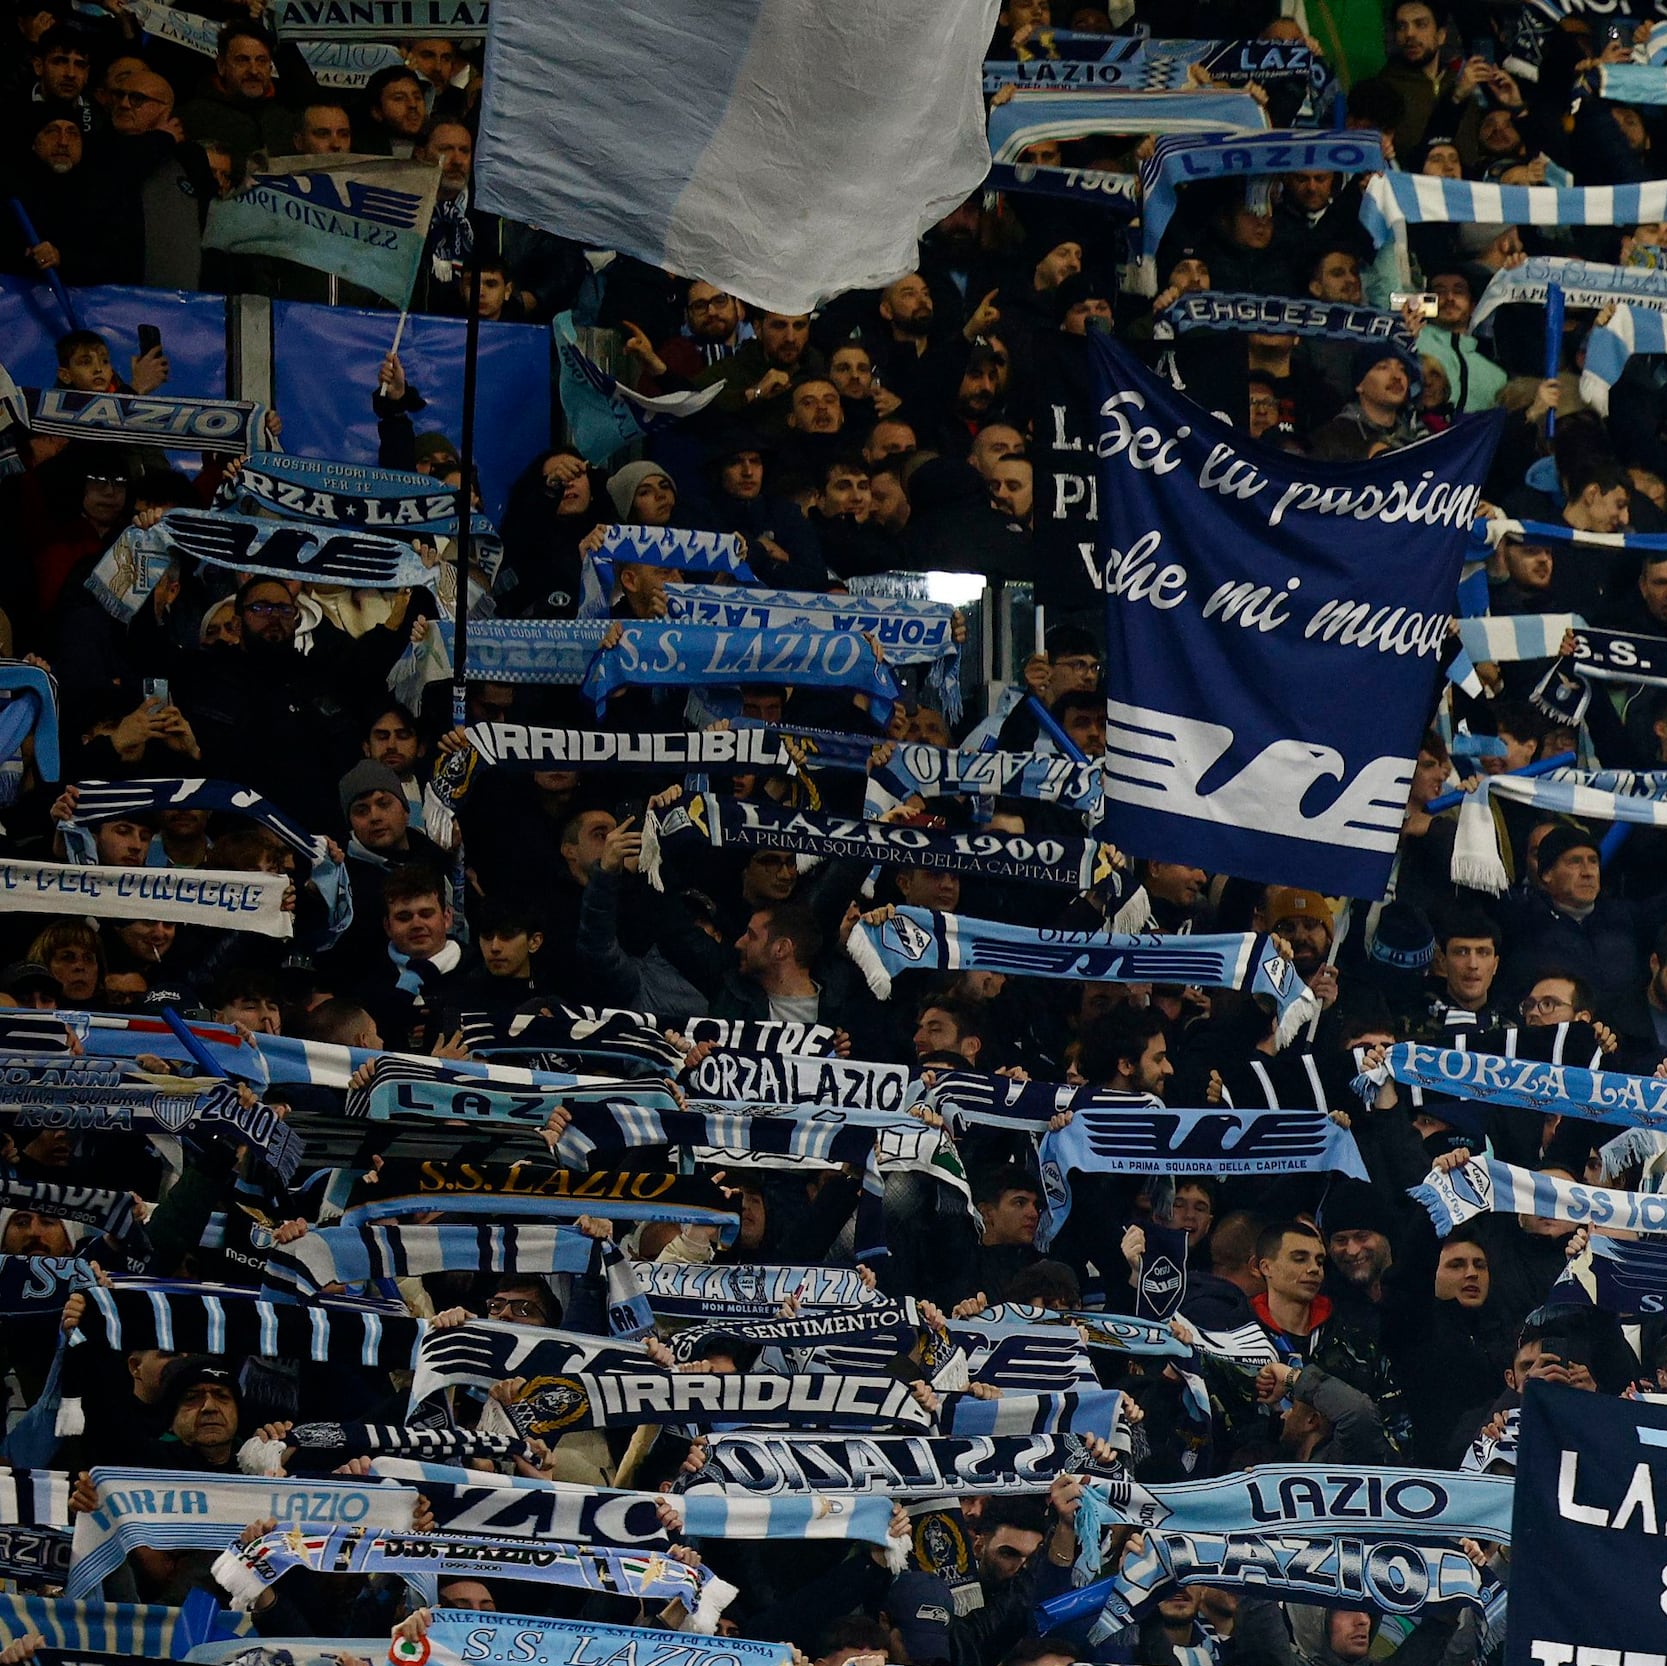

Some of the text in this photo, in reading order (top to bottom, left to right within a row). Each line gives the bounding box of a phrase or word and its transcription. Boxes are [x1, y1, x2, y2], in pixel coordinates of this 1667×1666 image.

[281, 1, 411, 26] AVANTI
[1020, 61, 1122, 83] LAZIO
[1181, 142, 1367, 175] LAZIO
[1188, 299, 1326, 332] EAGLES
[36, 388, 246, 437] LAZIO
[1097, 390, 1268, 499] Sei la
[271, 458, 366, 479] NOSTRI CUORI
[1203, 576, 1299, 632] mi
[620, 627, 861, 676] S.S. LAZIO
[1573, 632, 1652, 670] S.S.
[738, 801, 1065, 865] LAZIO 1900
[723, 827, 1079, 885] LA PRIMA SQUADRA CAPITALE
[118, 875, 263, 913] VINCERE
[1407, 1042, 1569, 1101] FORZA
[14, 1105, 132, 1131] ROMA
[418, 1160, 677, 1201] S.S. LAZIO
[1130, 1158, 1308, 1172] PRIMA SQUADRA DELLA CAPITALE
[1566, 1185, 1613, 1221] ss
[269, 1491, 371, 1524] LAZIO
[1246, 1474, 1449, 1524] LAZIO
[1171, 1535, 1431, 1617] LAZIO
[462, 1628, 550, 1665] S.S.
[731, 1639, 776, 1659] ROMA
